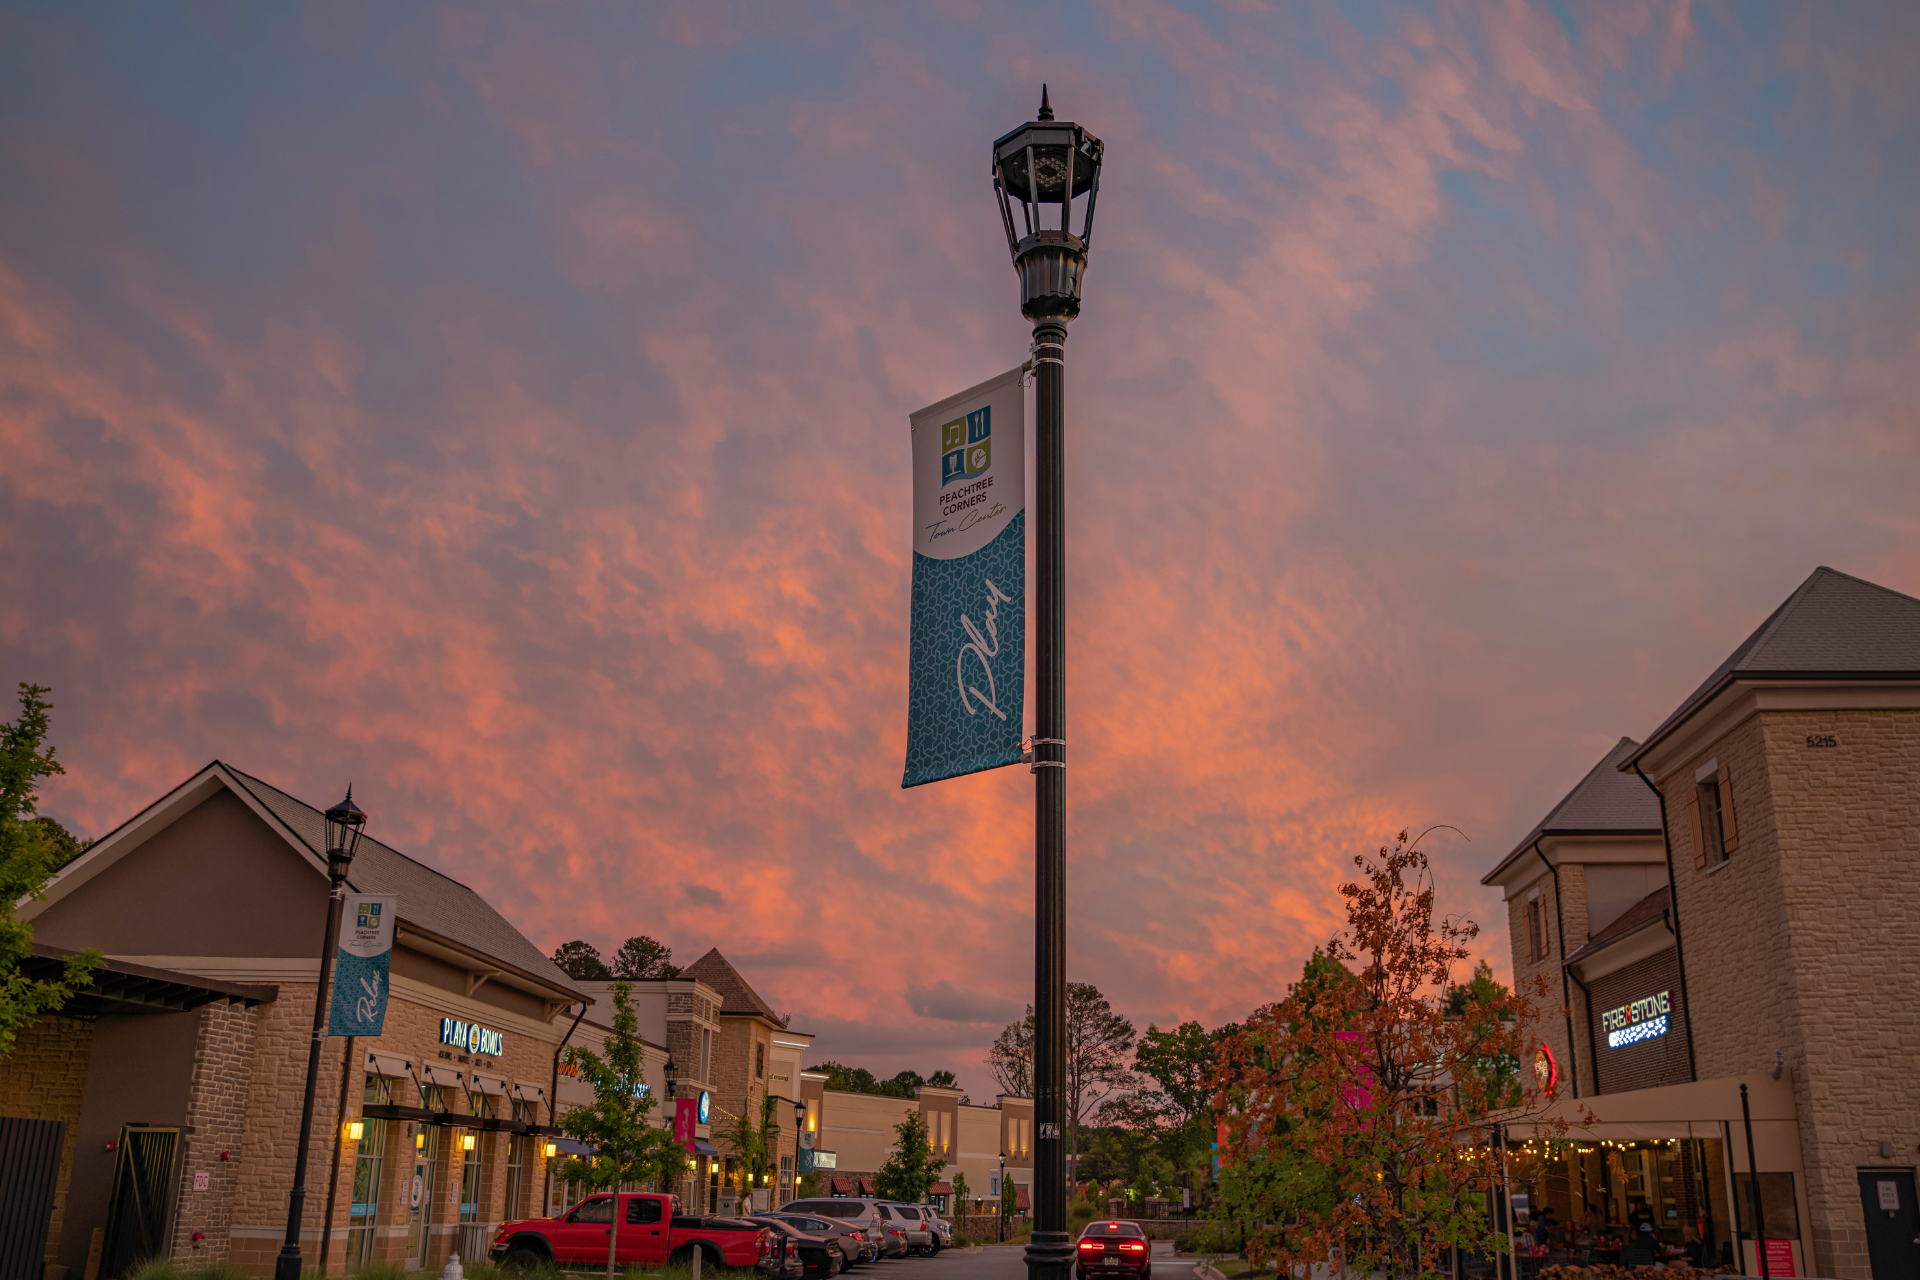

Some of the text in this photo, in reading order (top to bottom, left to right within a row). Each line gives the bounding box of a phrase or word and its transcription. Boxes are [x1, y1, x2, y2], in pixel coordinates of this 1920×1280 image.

[939, 476, 994, 506] PEACHTREE
[943, 491, 987, 516] CORNERS
[925, 501, 1007, 543] Town Center
[956, 578, 1012, 721] Play
[1806, 735, 1837, 748] 5215
[356, 969, 383, 1023] Relax
[442, 1017, 503, 1057] PLAYA BOWLS
[195, 1175, 208, 1187] FDC
